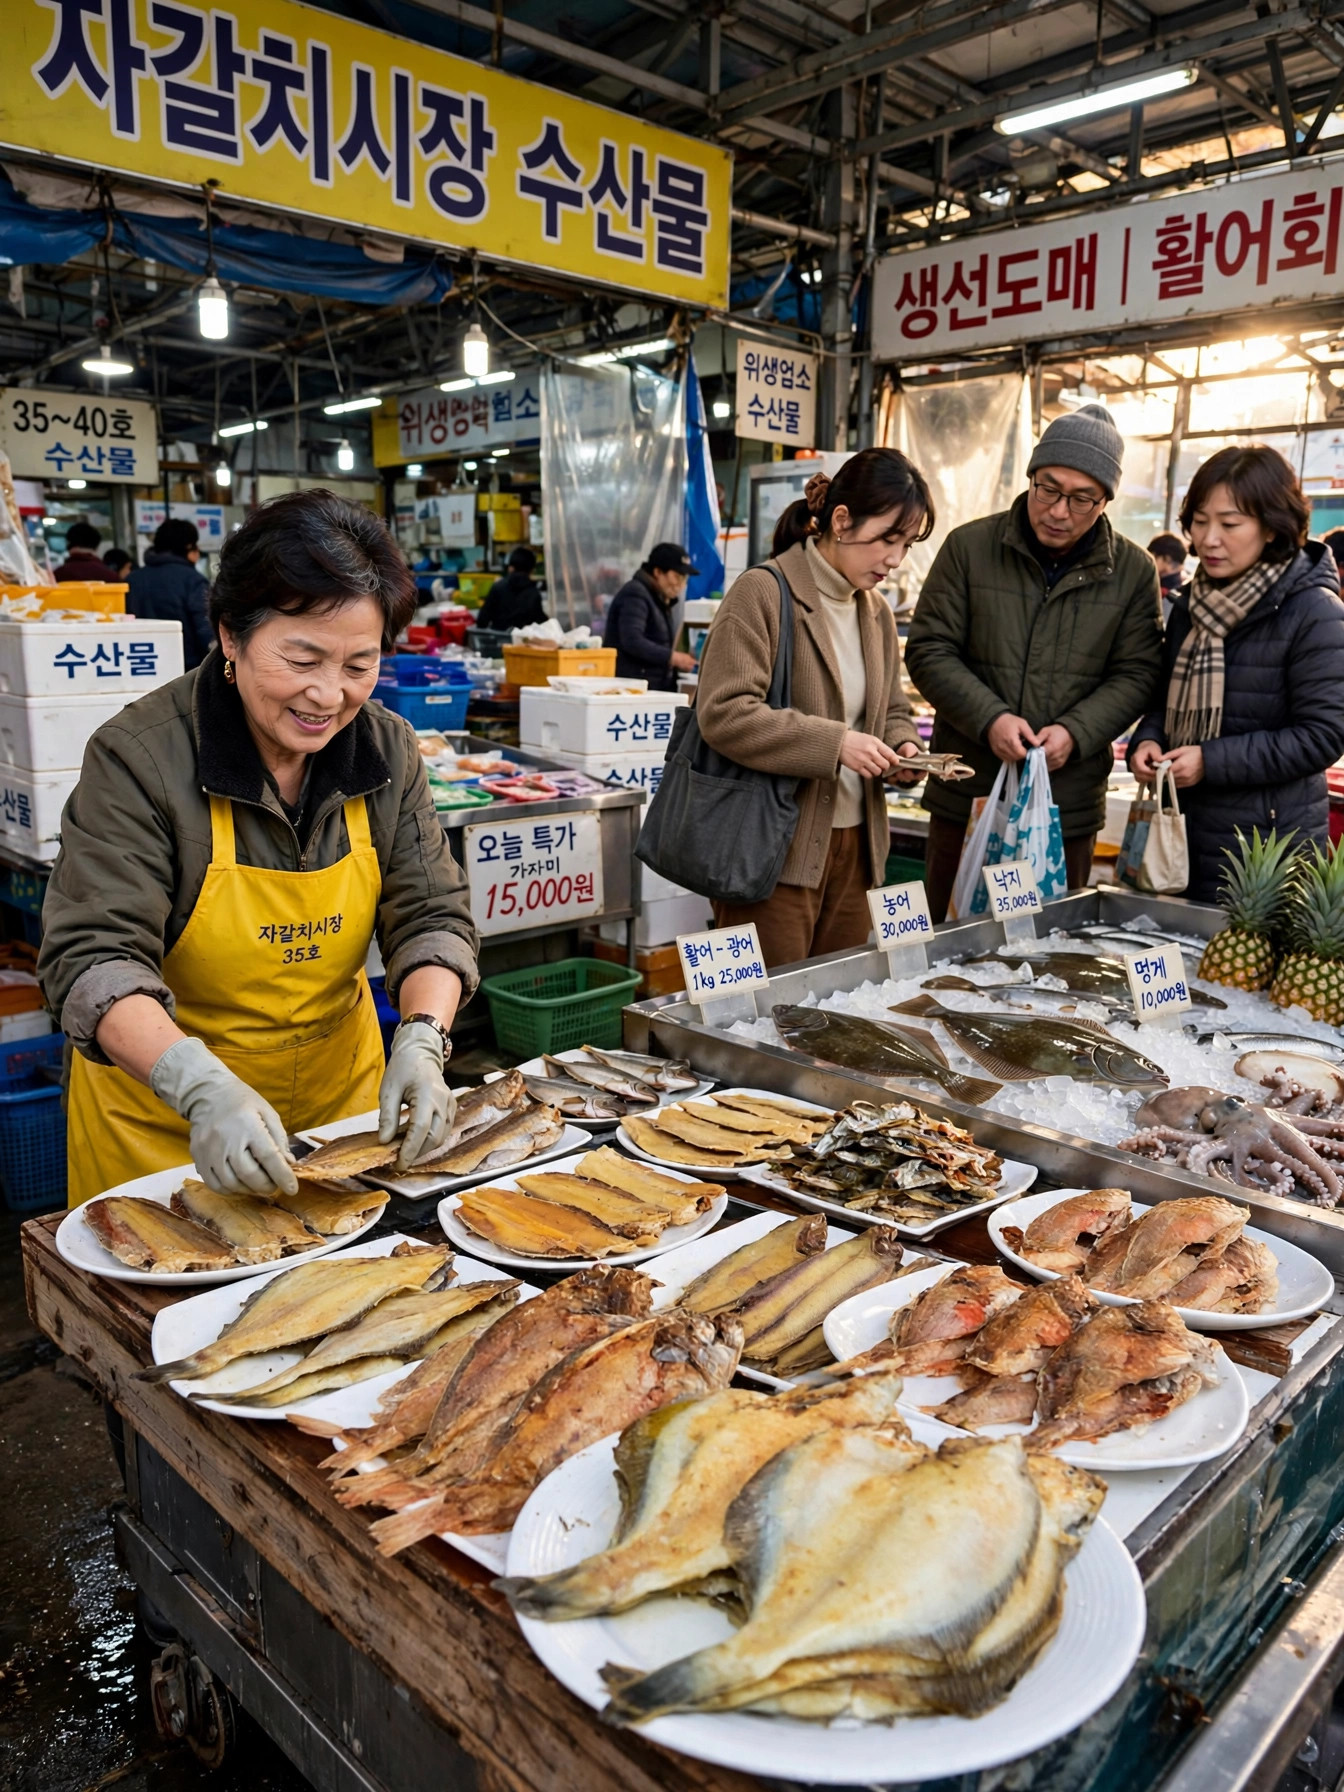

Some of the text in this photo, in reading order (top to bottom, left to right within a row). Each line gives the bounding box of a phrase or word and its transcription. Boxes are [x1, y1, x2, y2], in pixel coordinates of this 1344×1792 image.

[35, 0, 708, 277] 자갈치시장 수산물
[895, 187, 1344, 340] 생선도매 활어회
[13, 399, 136, 440] 35~40호
[747, 394, 801, 435] 수산물
[45, 442, 137, 476] 수산물
[53, 642, 159, 678] 수산물
[607, 713, 671, 741] 수산물
[0, 788, 31, 829] 산물
[477, 822, 576, 862] 오늘 특가
[510, 856, 560, 879] 가자미
[993, 869, 1022, 892] 낙지
[486, 872, 594, 919] 15,000원
[882, 891, 911, 917] 농어
[996, 890, 1038, 912] 35,000원
[258, 913, 343, 944] 자갈치시장
[881, 913, 930, 939] 30,000원
[282, 945, 322, 964] 35호
[683, 940, 714, 967] 활어
[726, 933, 754, 958] 광어
[719, 962, 764, 985] 25,000원
[1135, 955, 1167, 984] 멍게
[1142, 980, 1188, 1009] 10,000원
